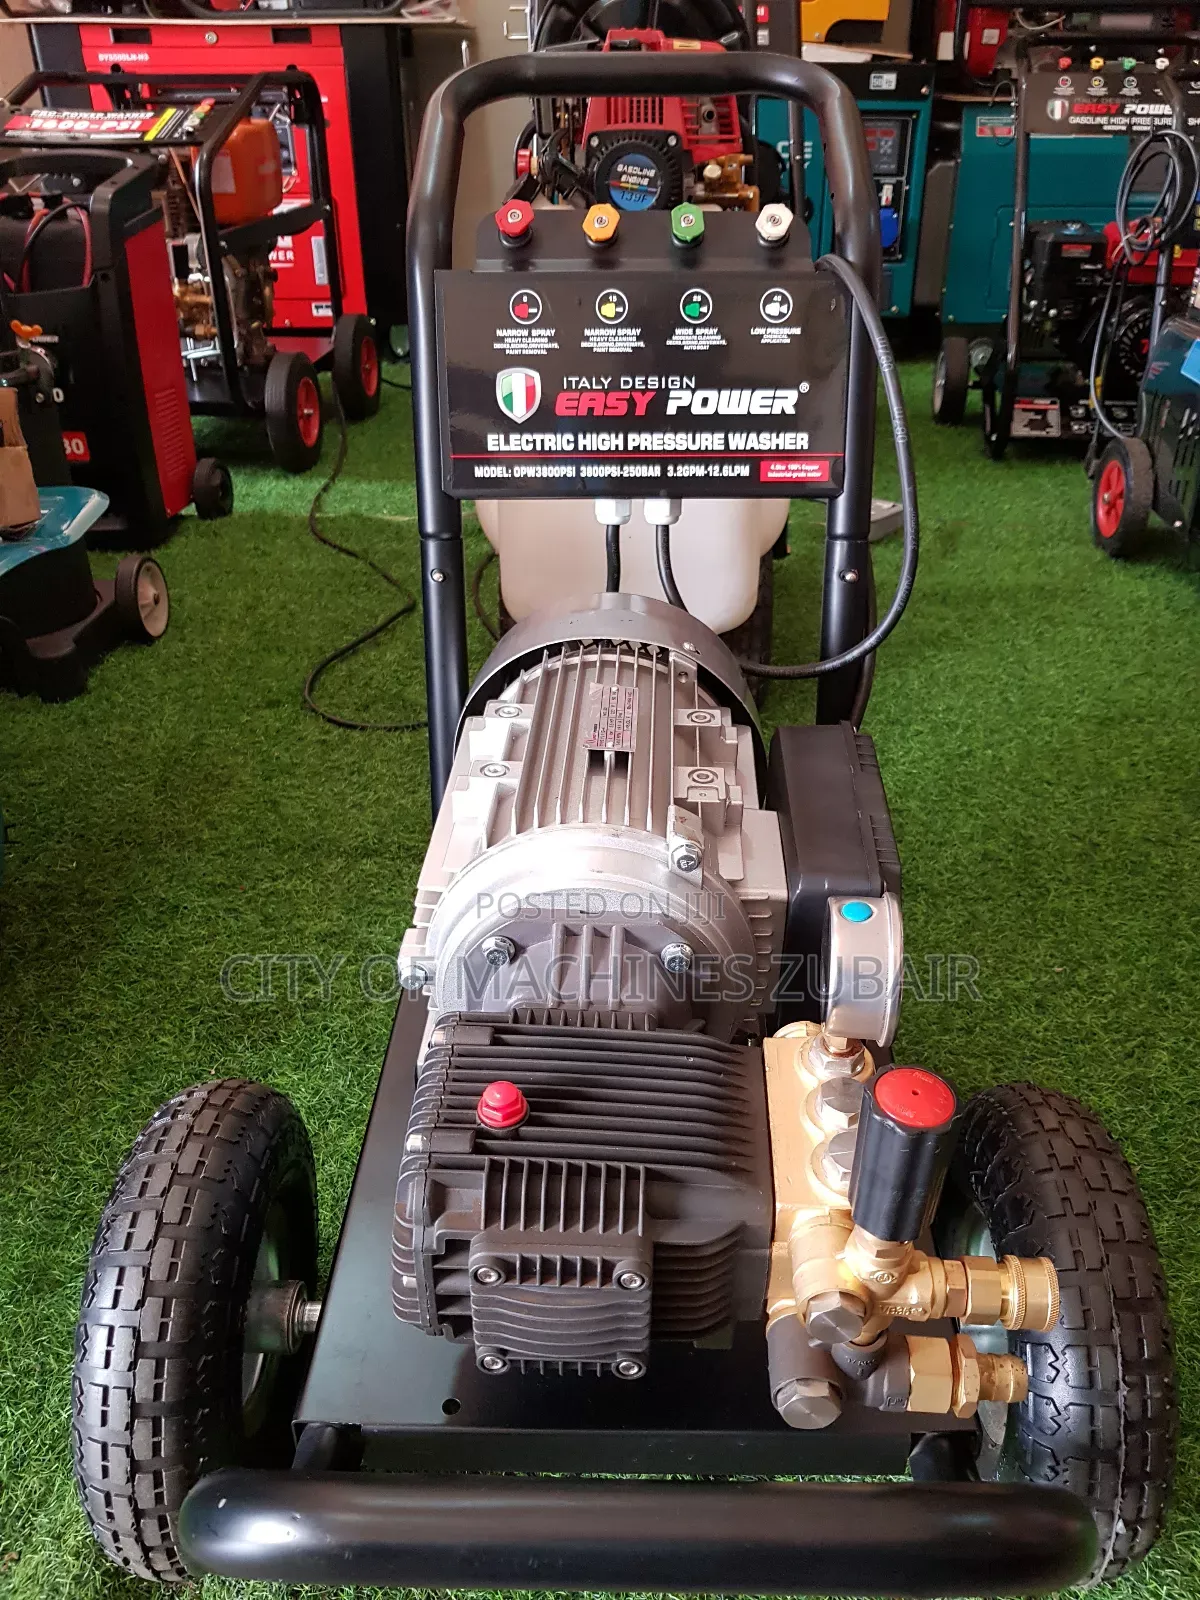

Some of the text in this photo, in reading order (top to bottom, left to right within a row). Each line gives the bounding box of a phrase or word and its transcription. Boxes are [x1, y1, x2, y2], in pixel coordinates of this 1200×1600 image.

[1073, 104, 1172, 115] EASY POWE
[1068, 116, 1108, 125] GASOLINE
[1109, 117, 1130, 125] HIGH
[617, 164, 656, 177] GASOLINE
[621, 174, 650, 186] ENGINE
[496, 328, 556, 337] NARROW SPRAY
[584, 328, 641, 337] NARROW SPRAY
[675, 327, 719, 335] WIDE SPRAY
[751, 327, 801, 335] LOW PRESSURE
[563, 375, 696, 390] ITALY DESIGN
[554, 391, 657, 416] EASY
[487, 432, 809, 451] ELECTRIC HIGH PRESSURE WASHER
[474, 465, 512, 478] MODEL:
[667, 464, 750, 478] 3.2GPM-12.6LPM
[801, 463, 820, 472] Copper
